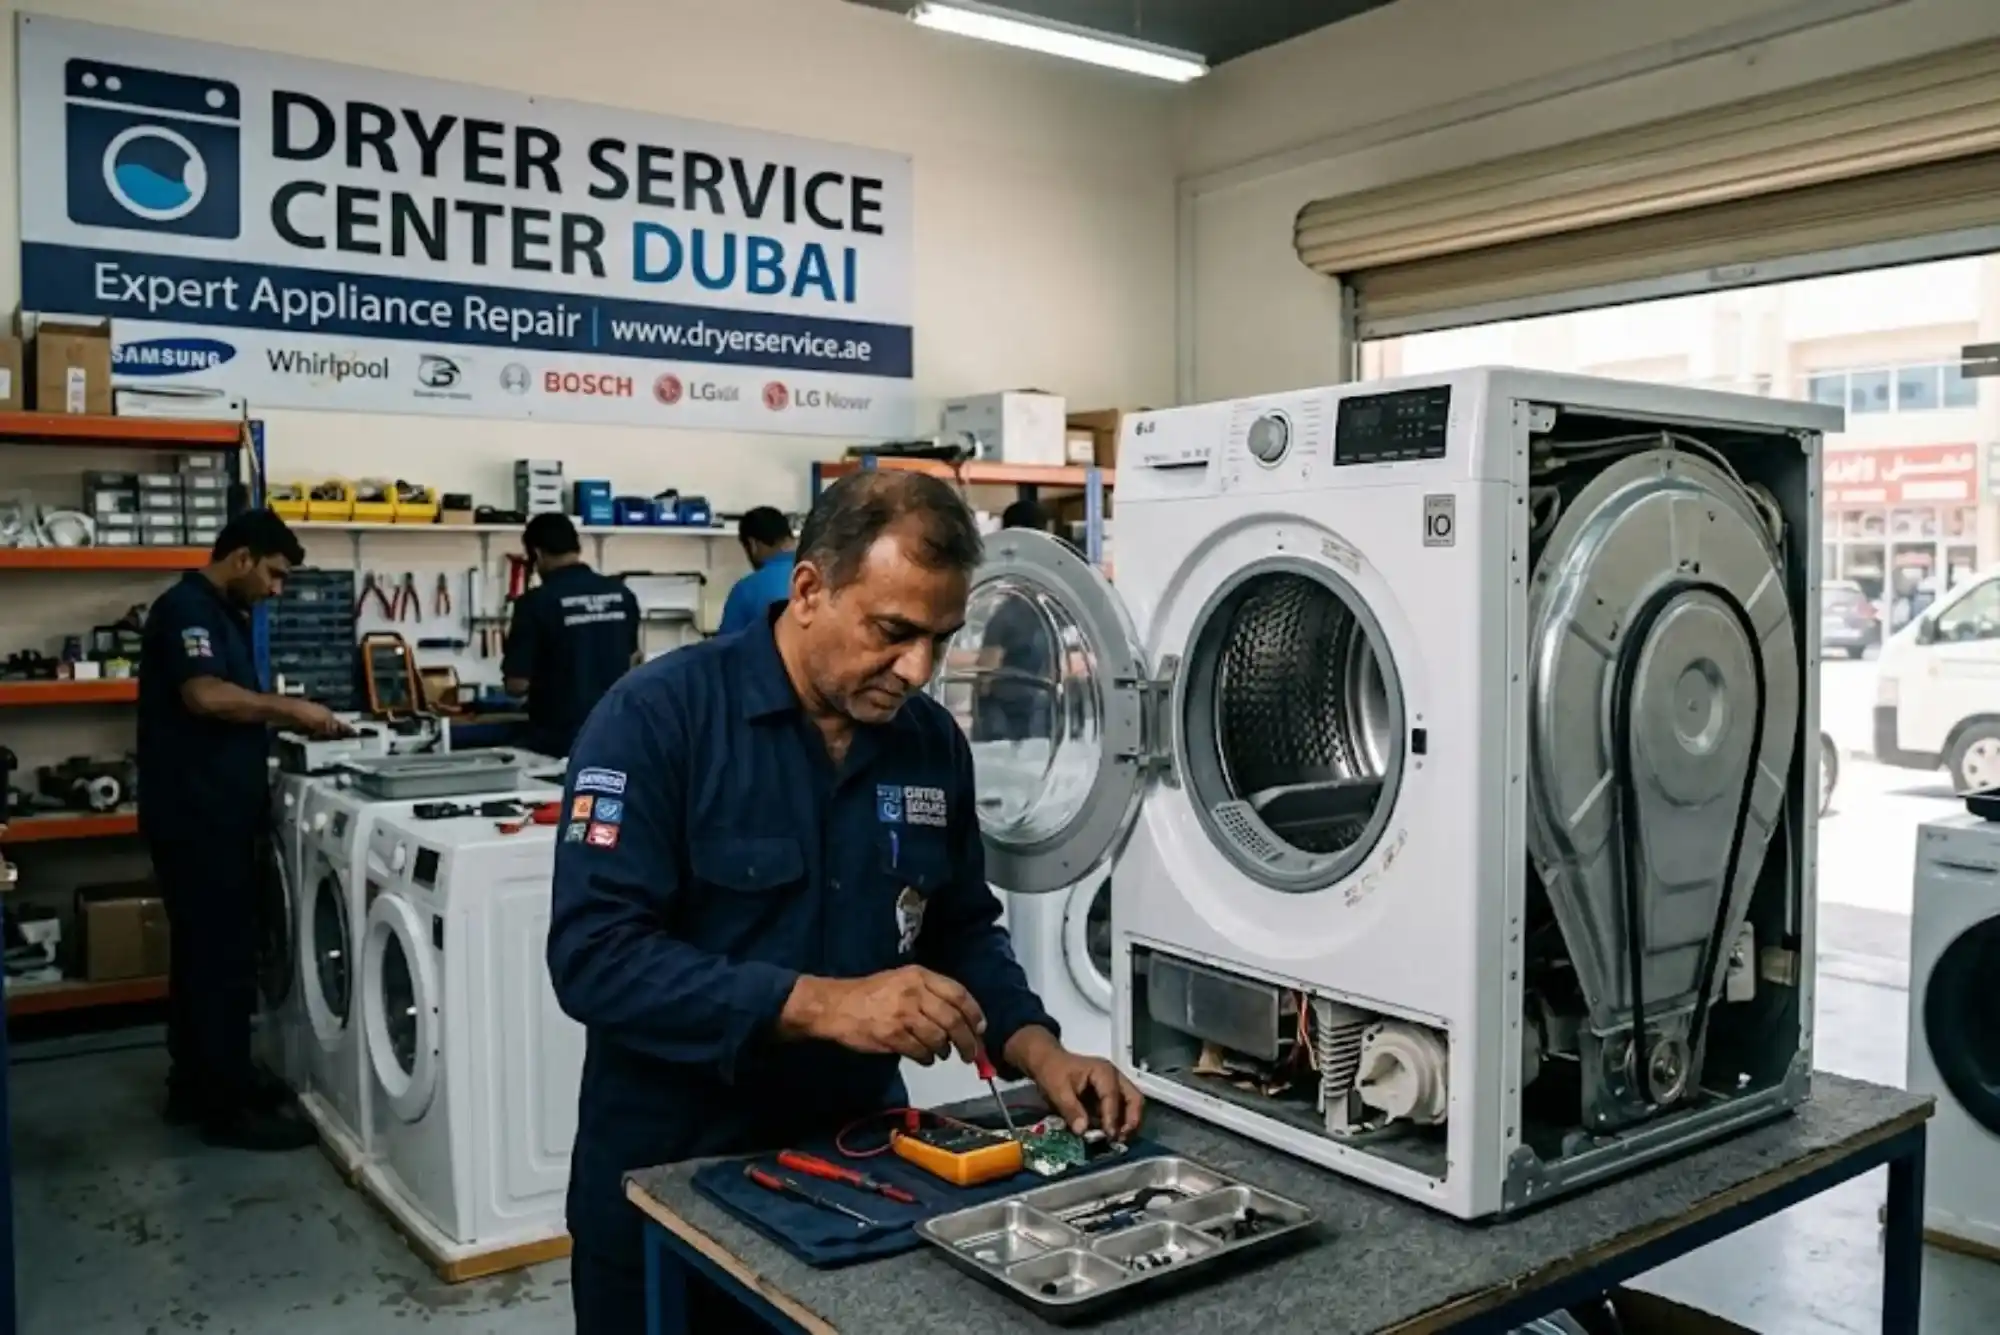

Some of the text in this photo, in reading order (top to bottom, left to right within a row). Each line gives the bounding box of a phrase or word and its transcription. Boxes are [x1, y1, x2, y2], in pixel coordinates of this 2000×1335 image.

[271, 89, 885, 236] DRYER SERVICE
[270, 180, 858, 304] CENTER DUBAI
[94, 261, 582, 342] Expert Appliance Repair
[611, 319, 872, 361] www.dryerservice.ae
[544, 371, 634, 397] BOSCH
[794, 388, 821, 408] LG
